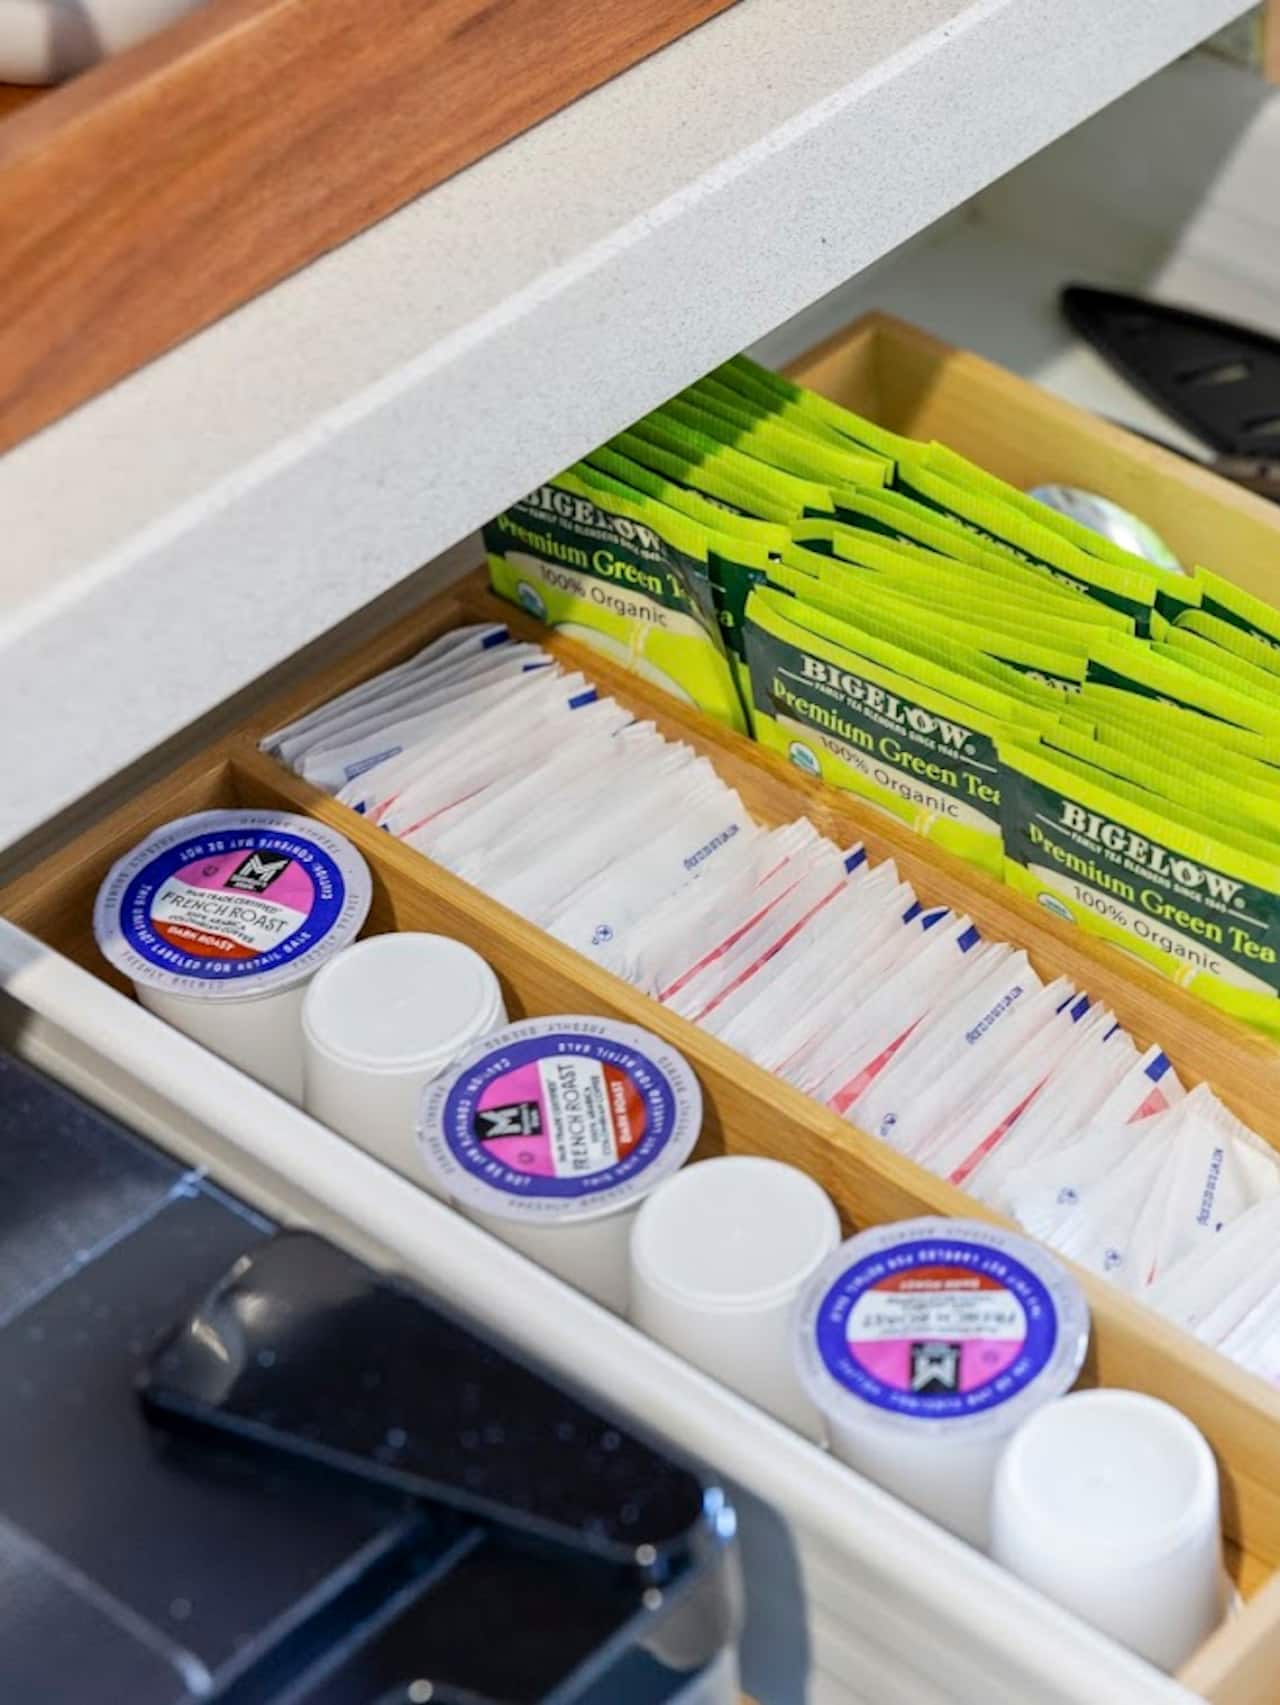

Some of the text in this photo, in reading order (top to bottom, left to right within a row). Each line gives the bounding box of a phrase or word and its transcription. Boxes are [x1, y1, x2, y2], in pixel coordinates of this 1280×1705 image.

[496, 512, 589, 568] Premium
[592, 549, 663, 595] Green
[591, 586, 668, 627] Organic
[772, 676, 875, 751] Premium
[879, 737, 959, 788] Green
[800, 653, 974, 751] BIGELOW
[820, 735, 960, 818] 100% Organic
[1059, 799, 1244, 903] BIGELOW
[160, 890, 288, 933] FRENCH ROAST
[1029, 822, 1278, 964] Premium Green Tea
[1073, 884, 1221, 976] 100% Organic
[197, 933, 236, 952] ROAST
[204, 963, 228, 971] FOR
[238, 952, 280, 968] RETAIL
[282, 932, 312, 952] SALE
[556, 1063, 581, 1112] ROAST
